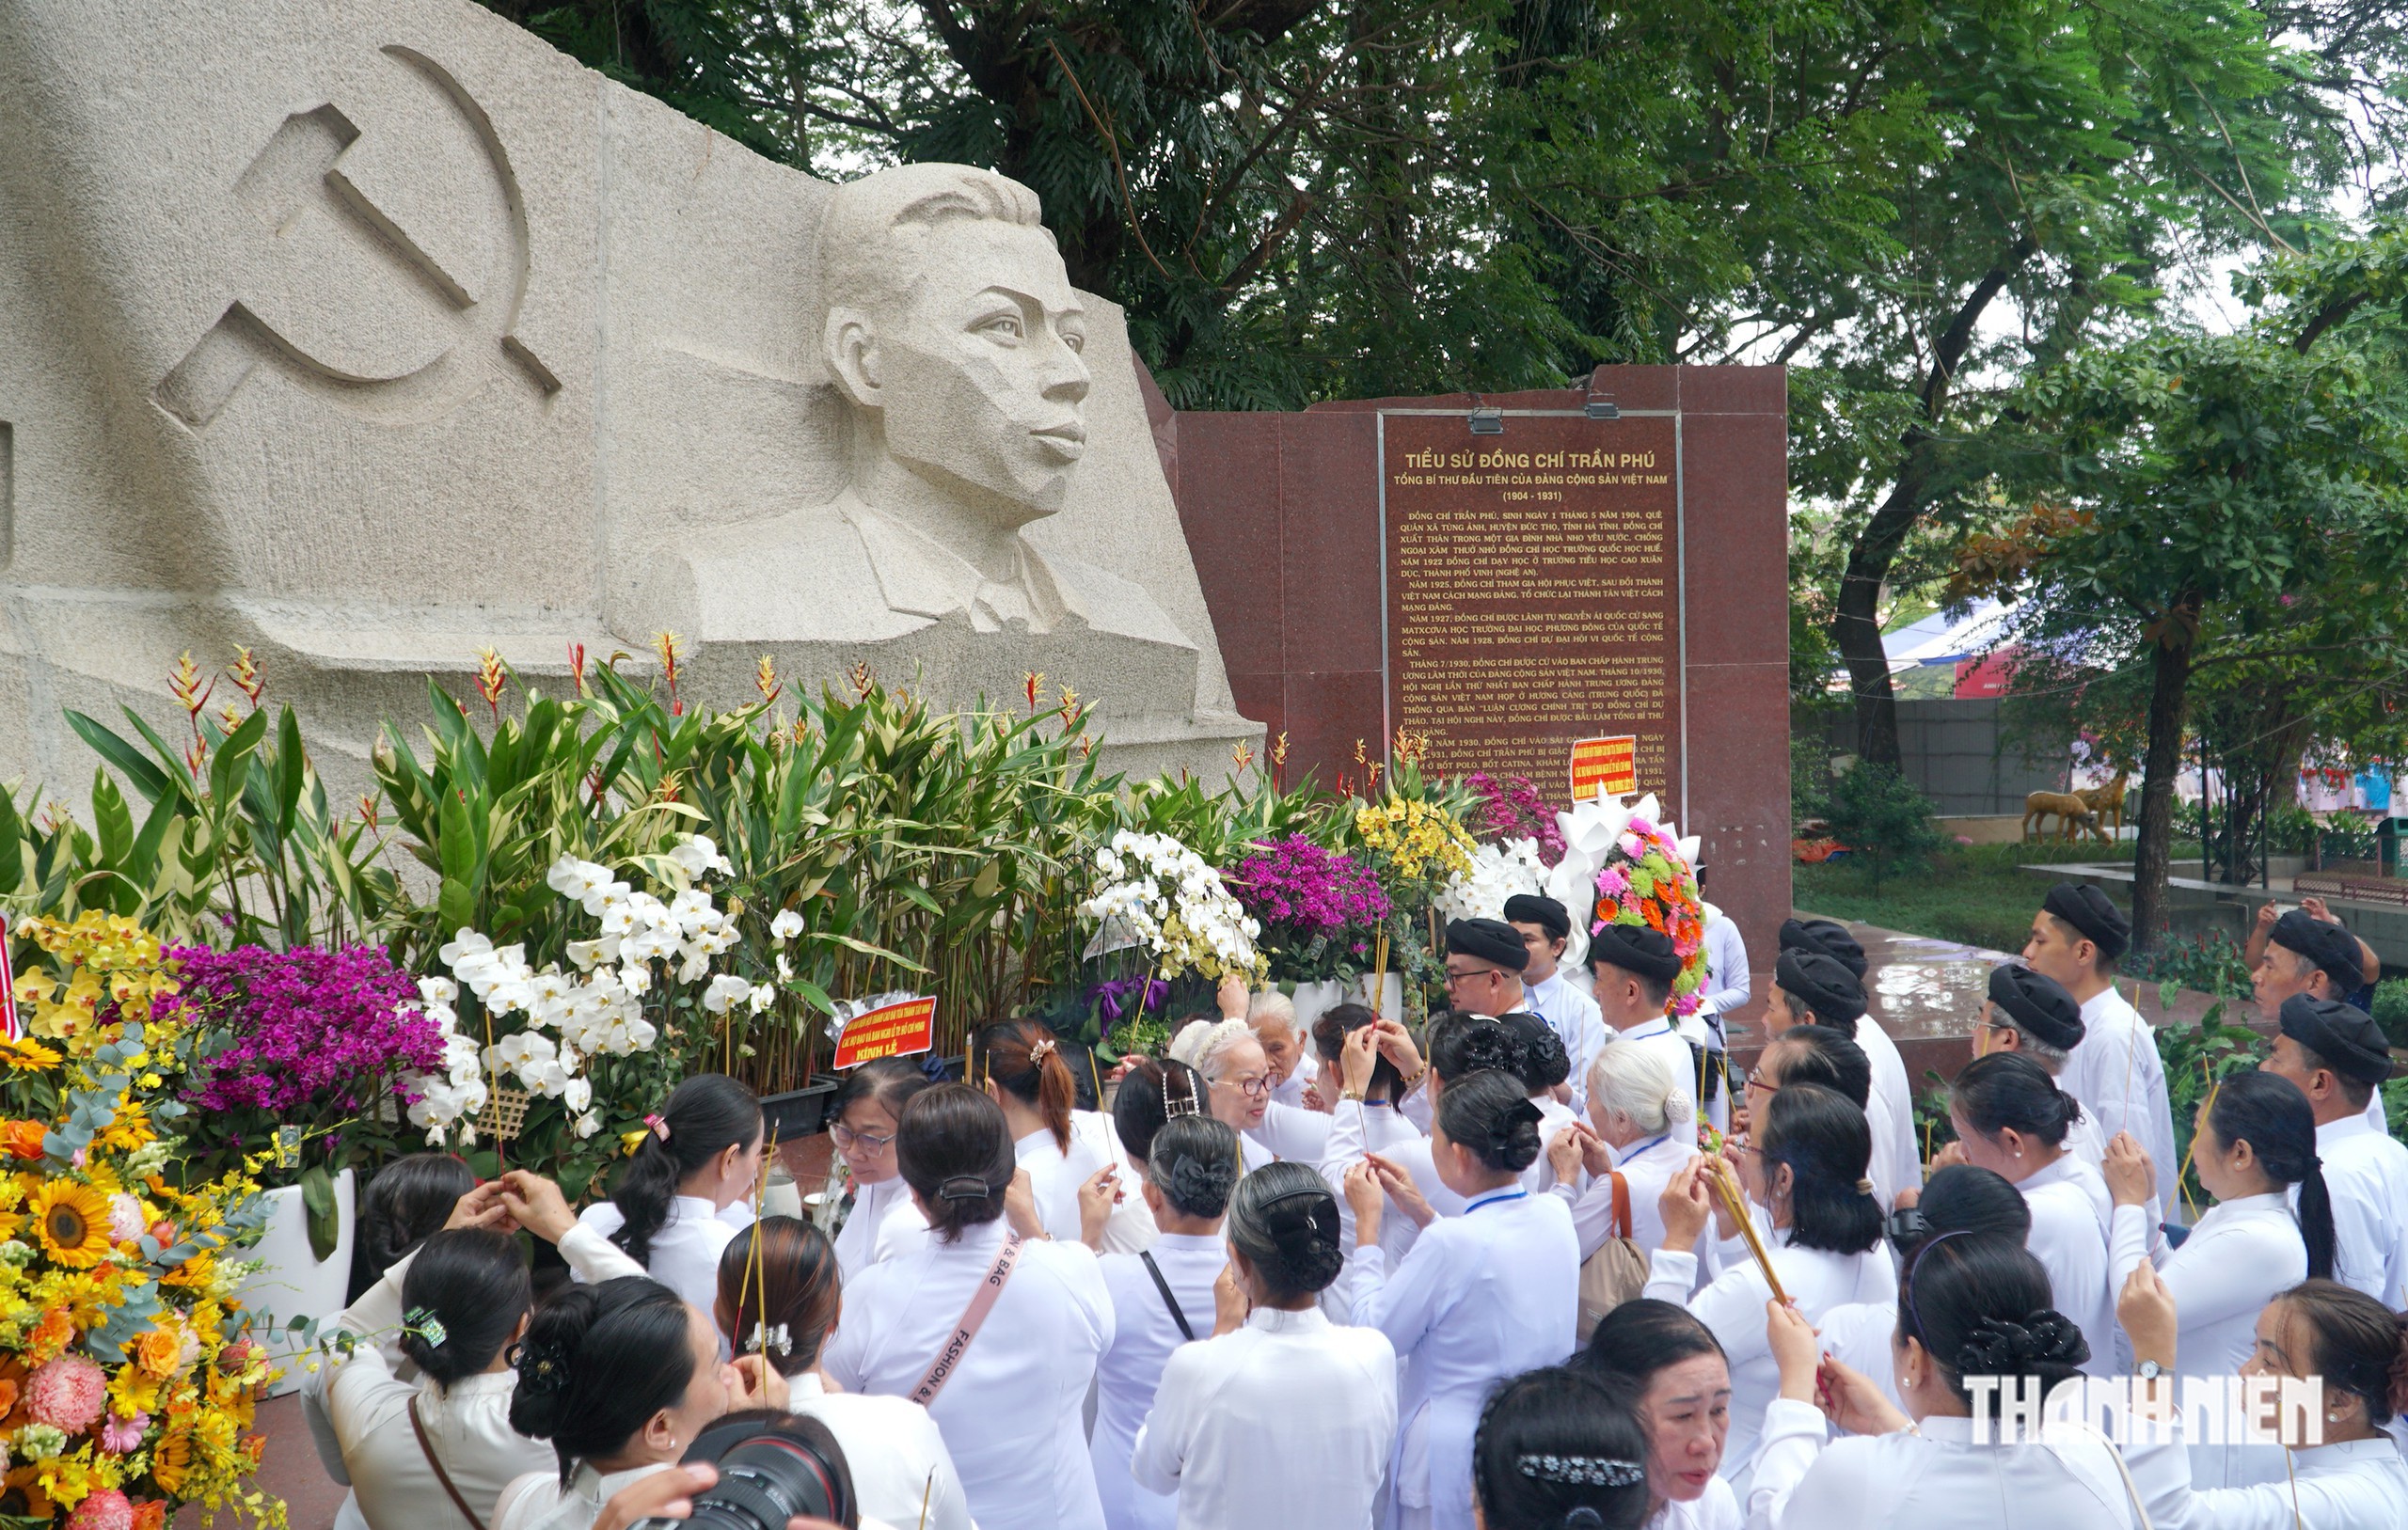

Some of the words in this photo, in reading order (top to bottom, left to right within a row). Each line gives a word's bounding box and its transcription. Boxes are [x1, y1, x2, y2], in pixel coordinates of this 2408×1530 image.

[1405, 447, 1445, 467] TIỂU
[1450, 450, 1475, 467] SỬ
[1479, 448, 1529, 467] ĐỒNG
[1535, 450, 1564, 467] CHÍ
[1568, 448, 1614, 467] TRẦN
[1621, 450, 1655, 467] PHÚ
[1426, 474, 1435, 485] BÍ
[1438, 476, 1459, 485] THƯ
[1485, 474, 1508, 485] TIÊN
[1566, 474, 1595, 486] CỘNG
[1621, 473, 1643, 486] VIỆT
[1646, 475, 1667, 484] NAM
[1502, 492, 1528, 502] (1904
[1537, 492, 1561, 502] 1931)
[856, 1046, 882, 1061] KÍNH
[990, 1259, 1010, 1286] BAG
[927, 1330, 970, 1387] FASHION
[918, 1387, 931, 1397] &
